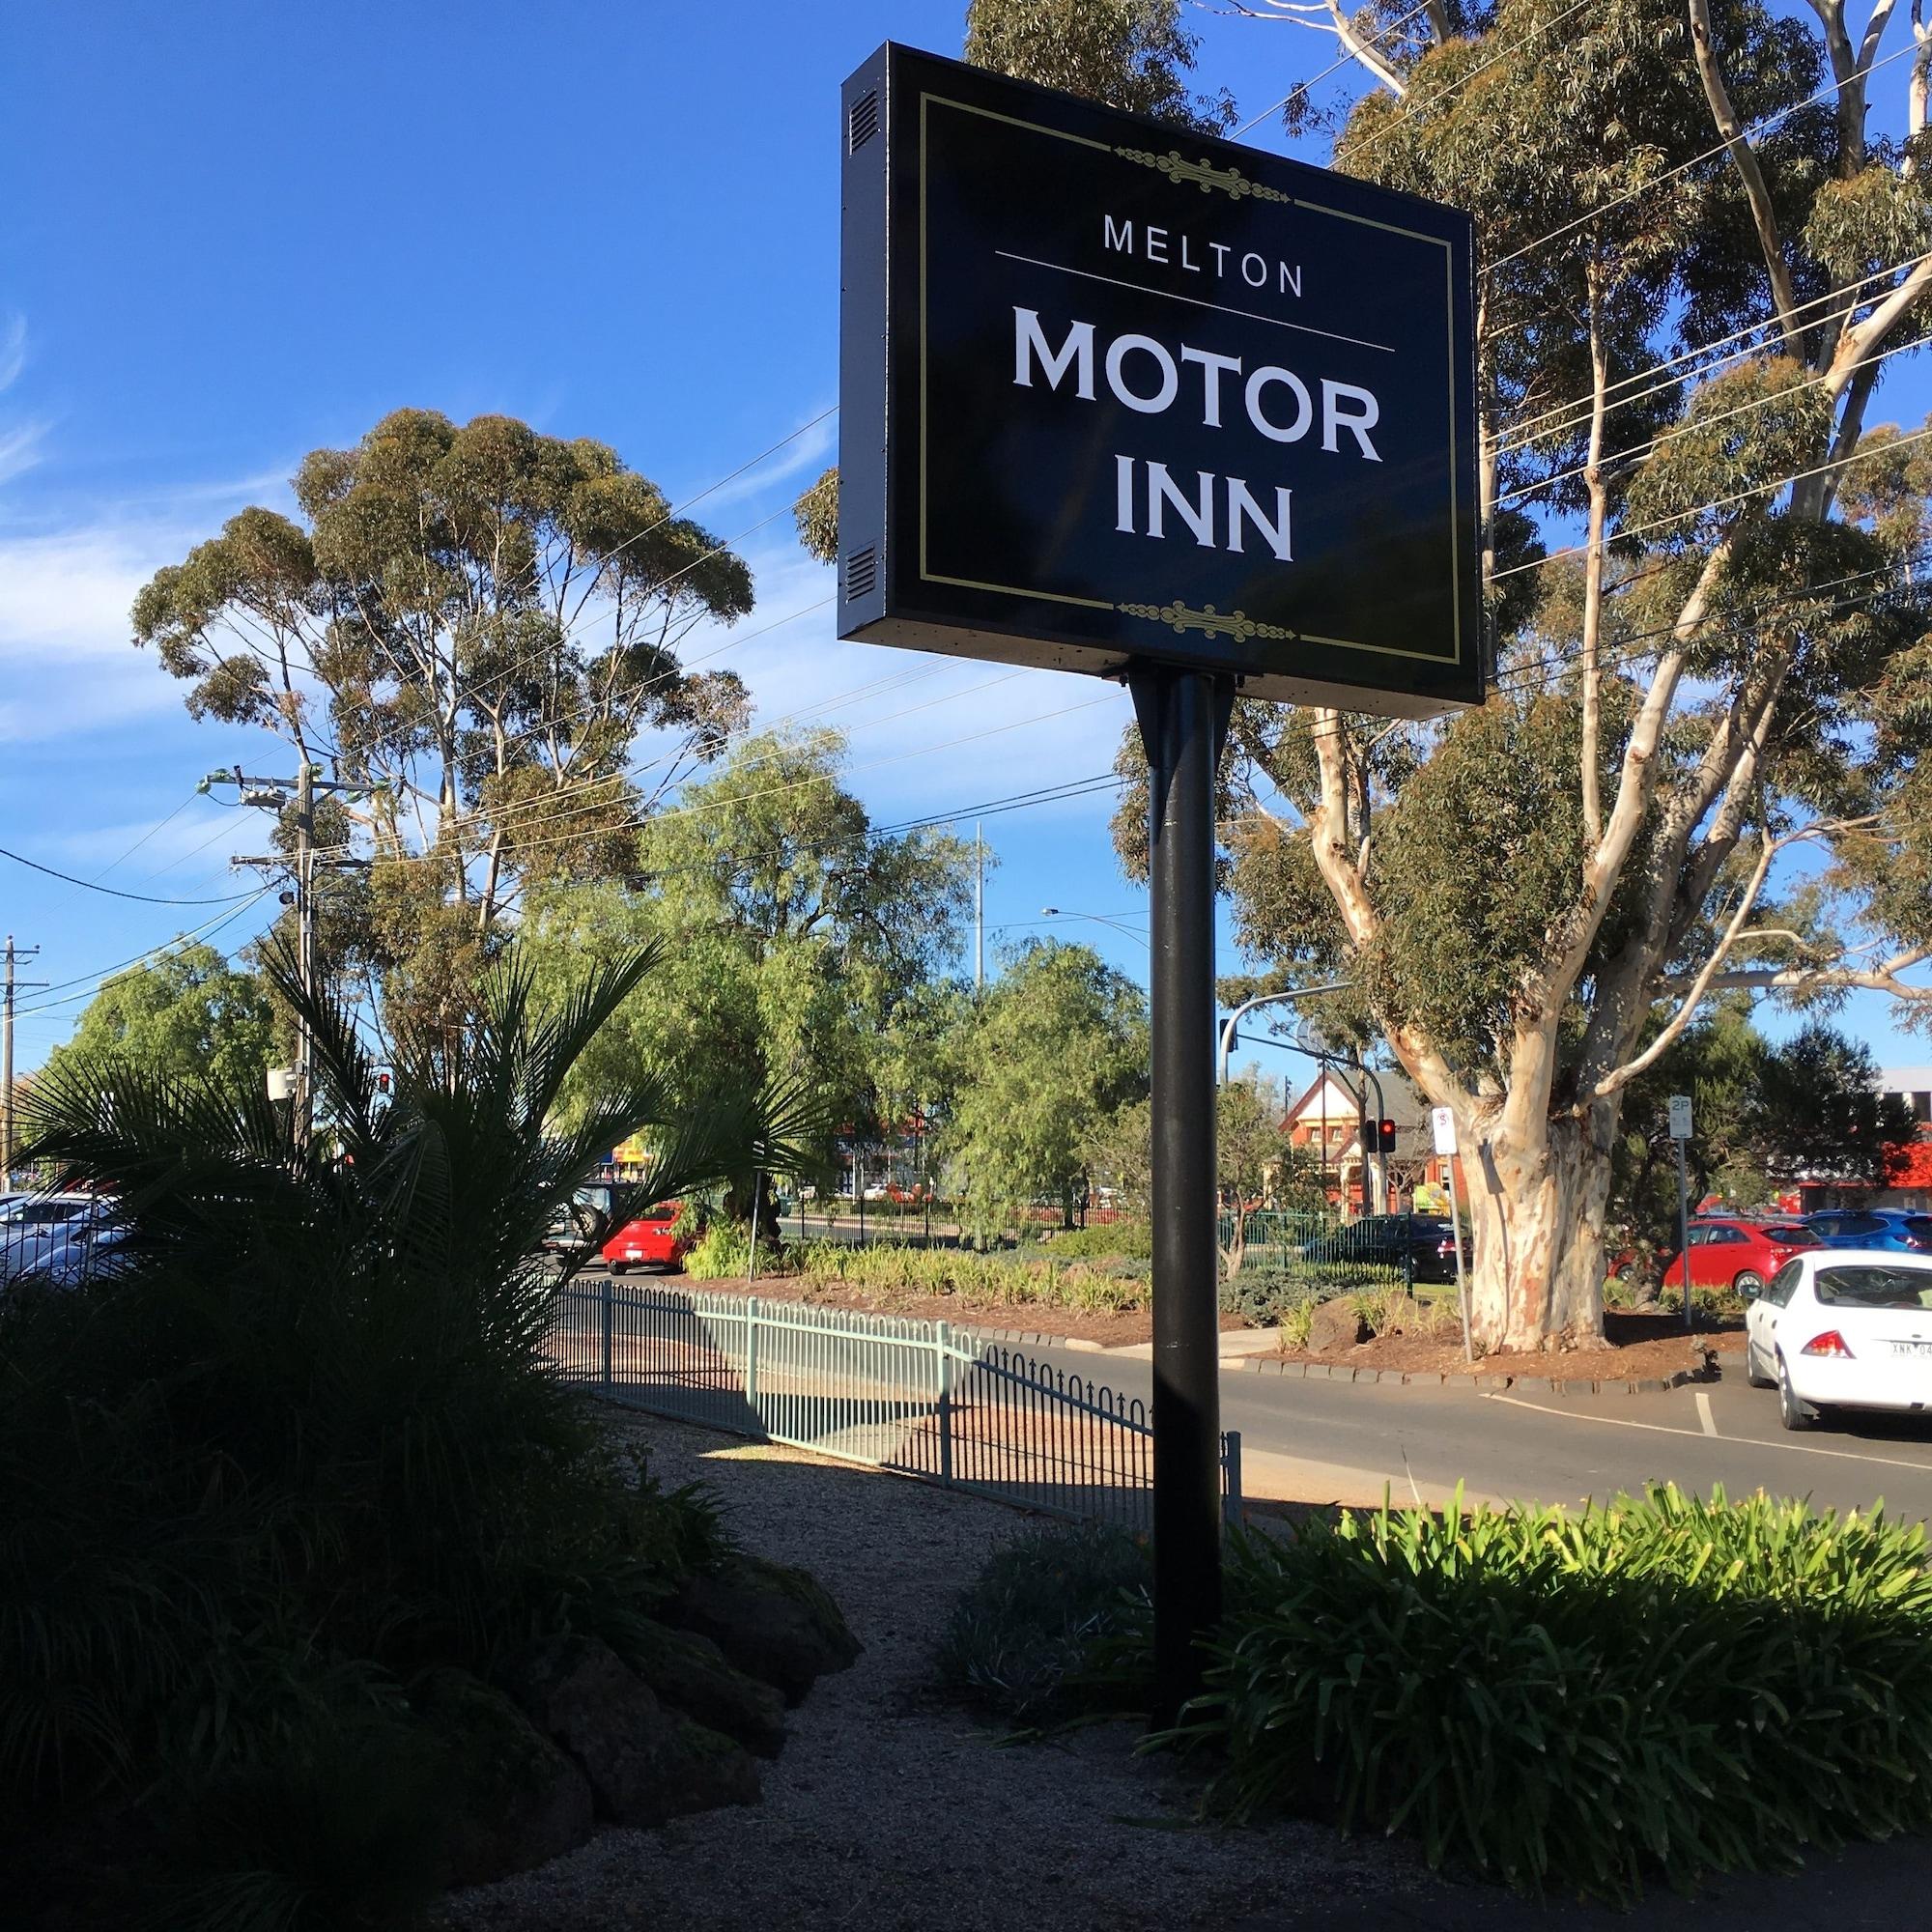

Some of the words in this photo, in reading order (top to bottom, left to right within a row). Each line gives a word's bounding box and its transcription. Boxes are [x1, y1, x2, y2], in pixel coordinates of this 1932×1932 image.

[1104, 213, 1302, 298] MELTON
[1012, 305, 1383, 463] MOTOR
[1115, 454, 1293, 562] INN
[1672, 1100, 1689, 1111] 2P
